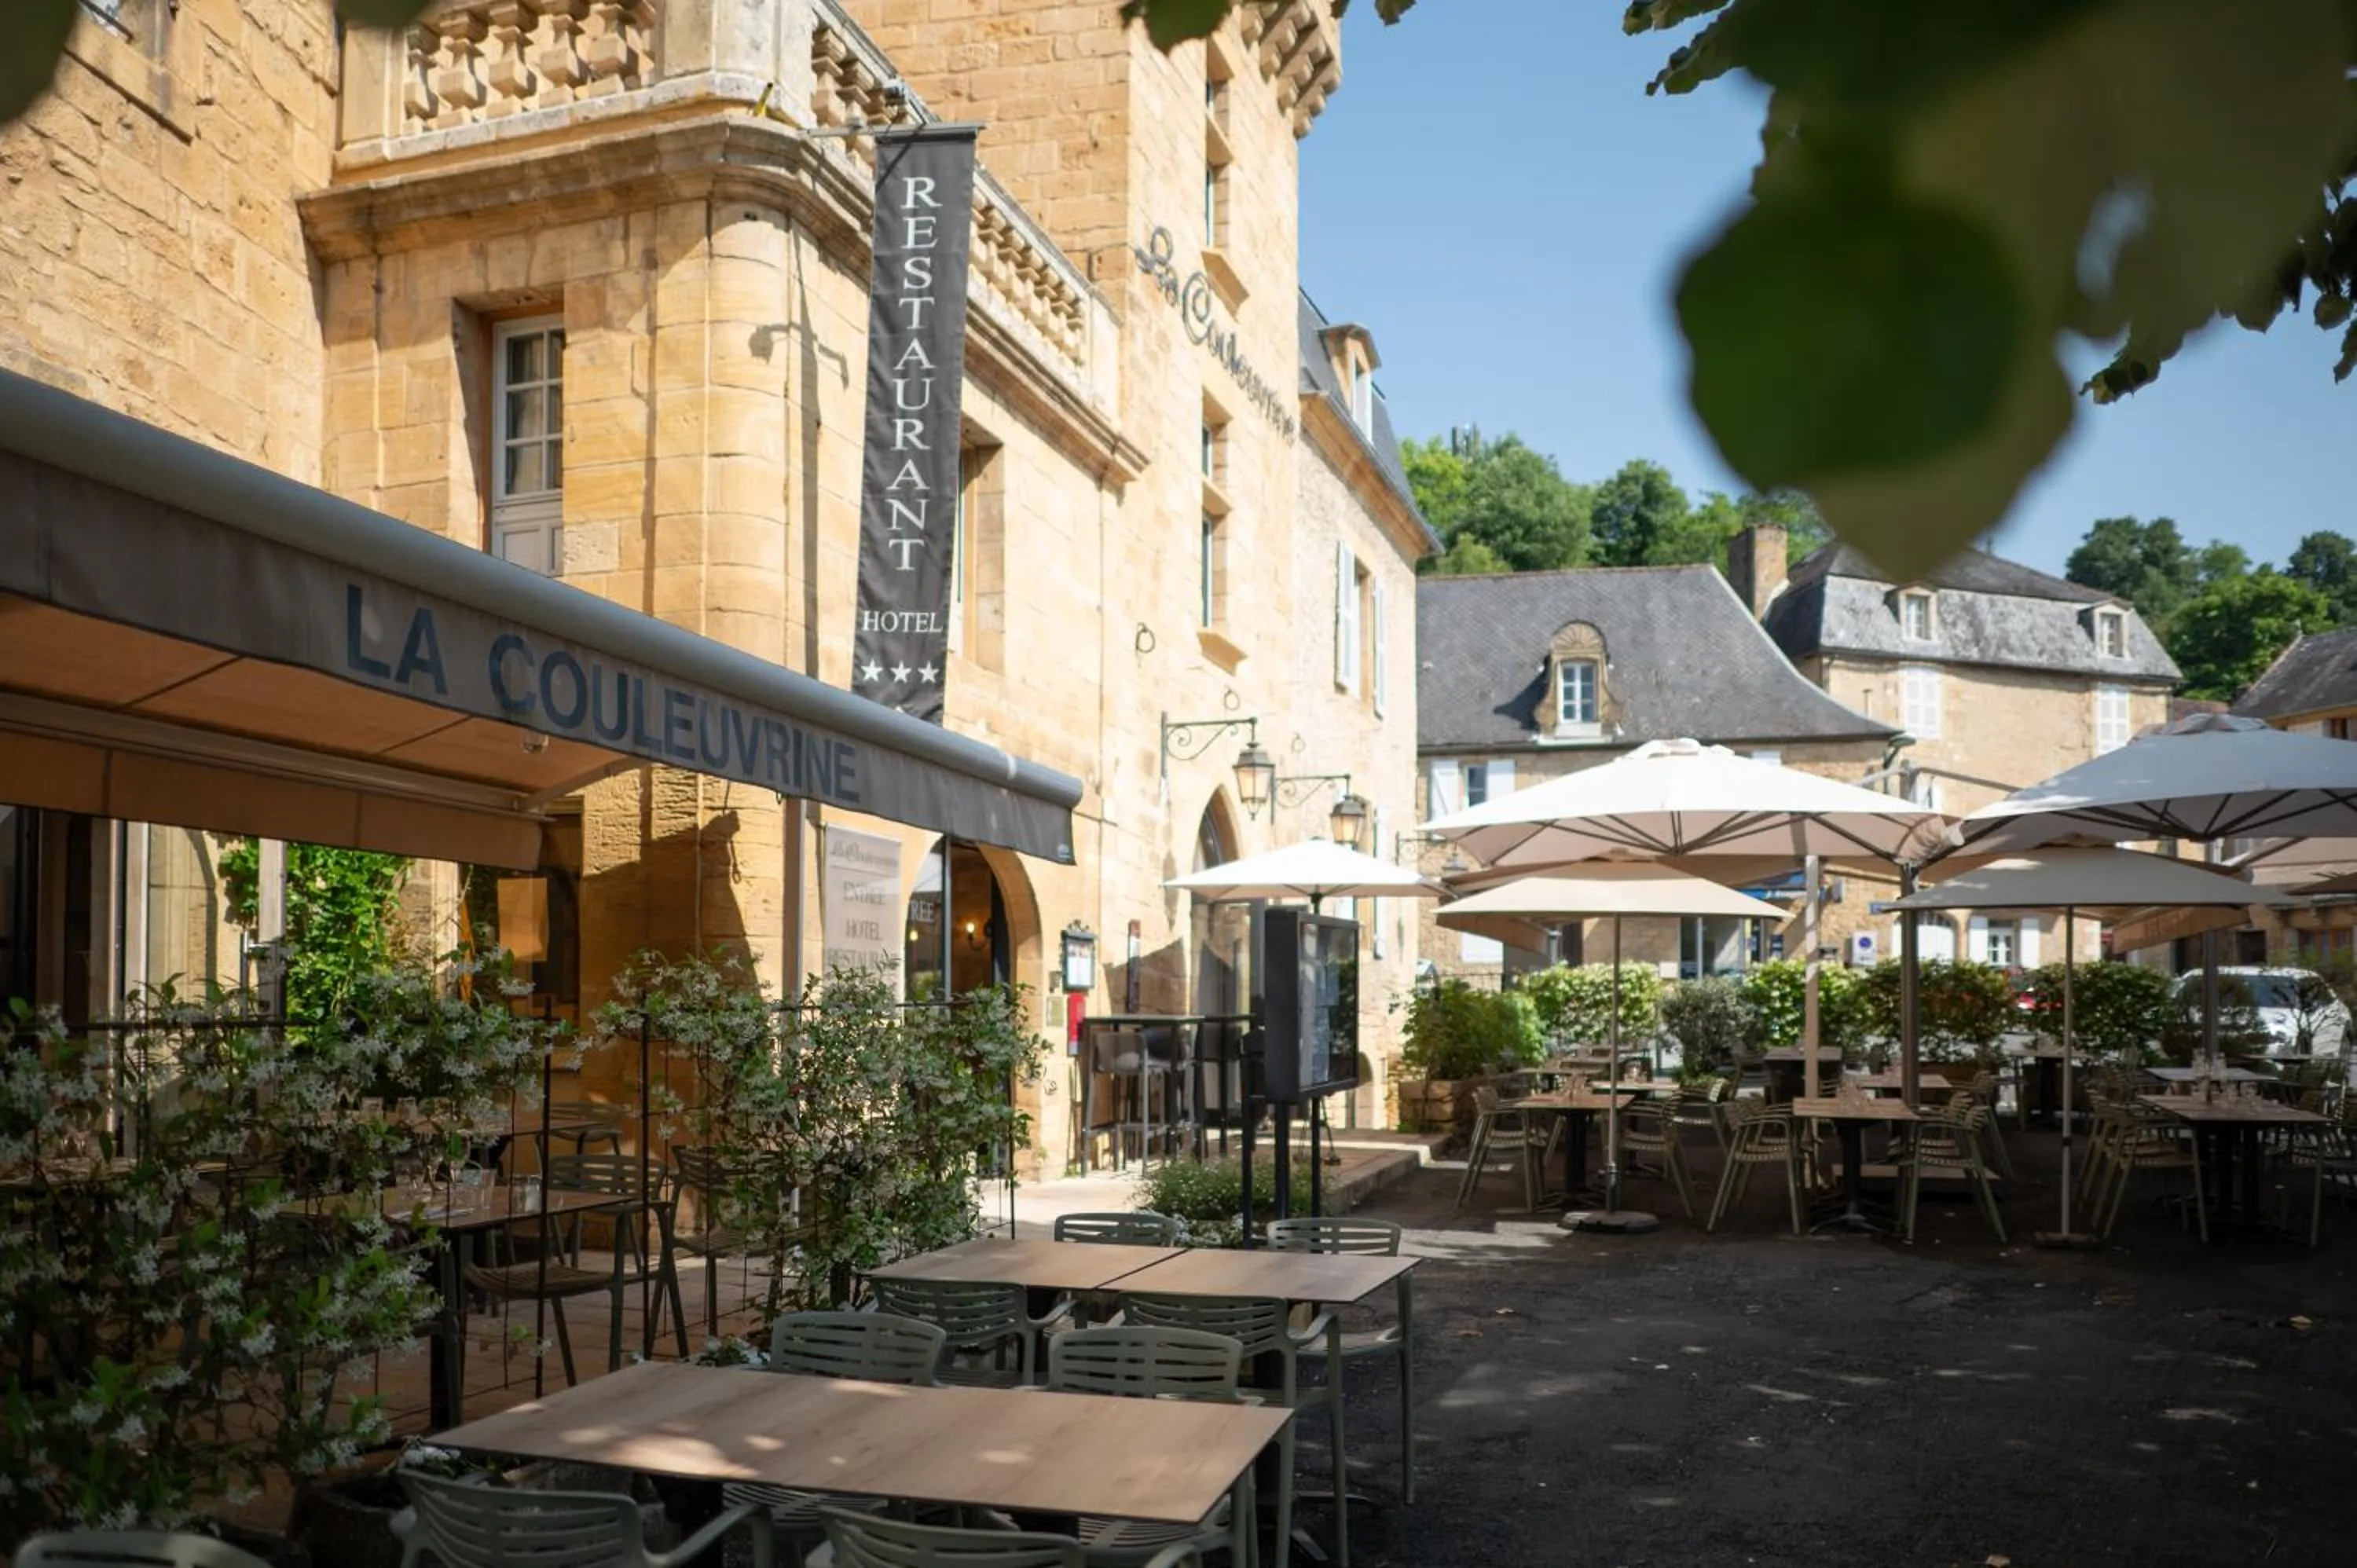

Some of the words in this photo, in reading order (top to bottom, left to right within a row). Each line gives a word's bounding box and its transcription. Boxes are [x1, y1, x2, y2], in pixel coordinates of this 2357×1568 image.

[886, 177, 943, 571] RESTAURANT
[346, 583, 448, 695] LA
[488, 633, 861, 804] COULEUVRINE
[863, 610, 943, 633] HOTEL
